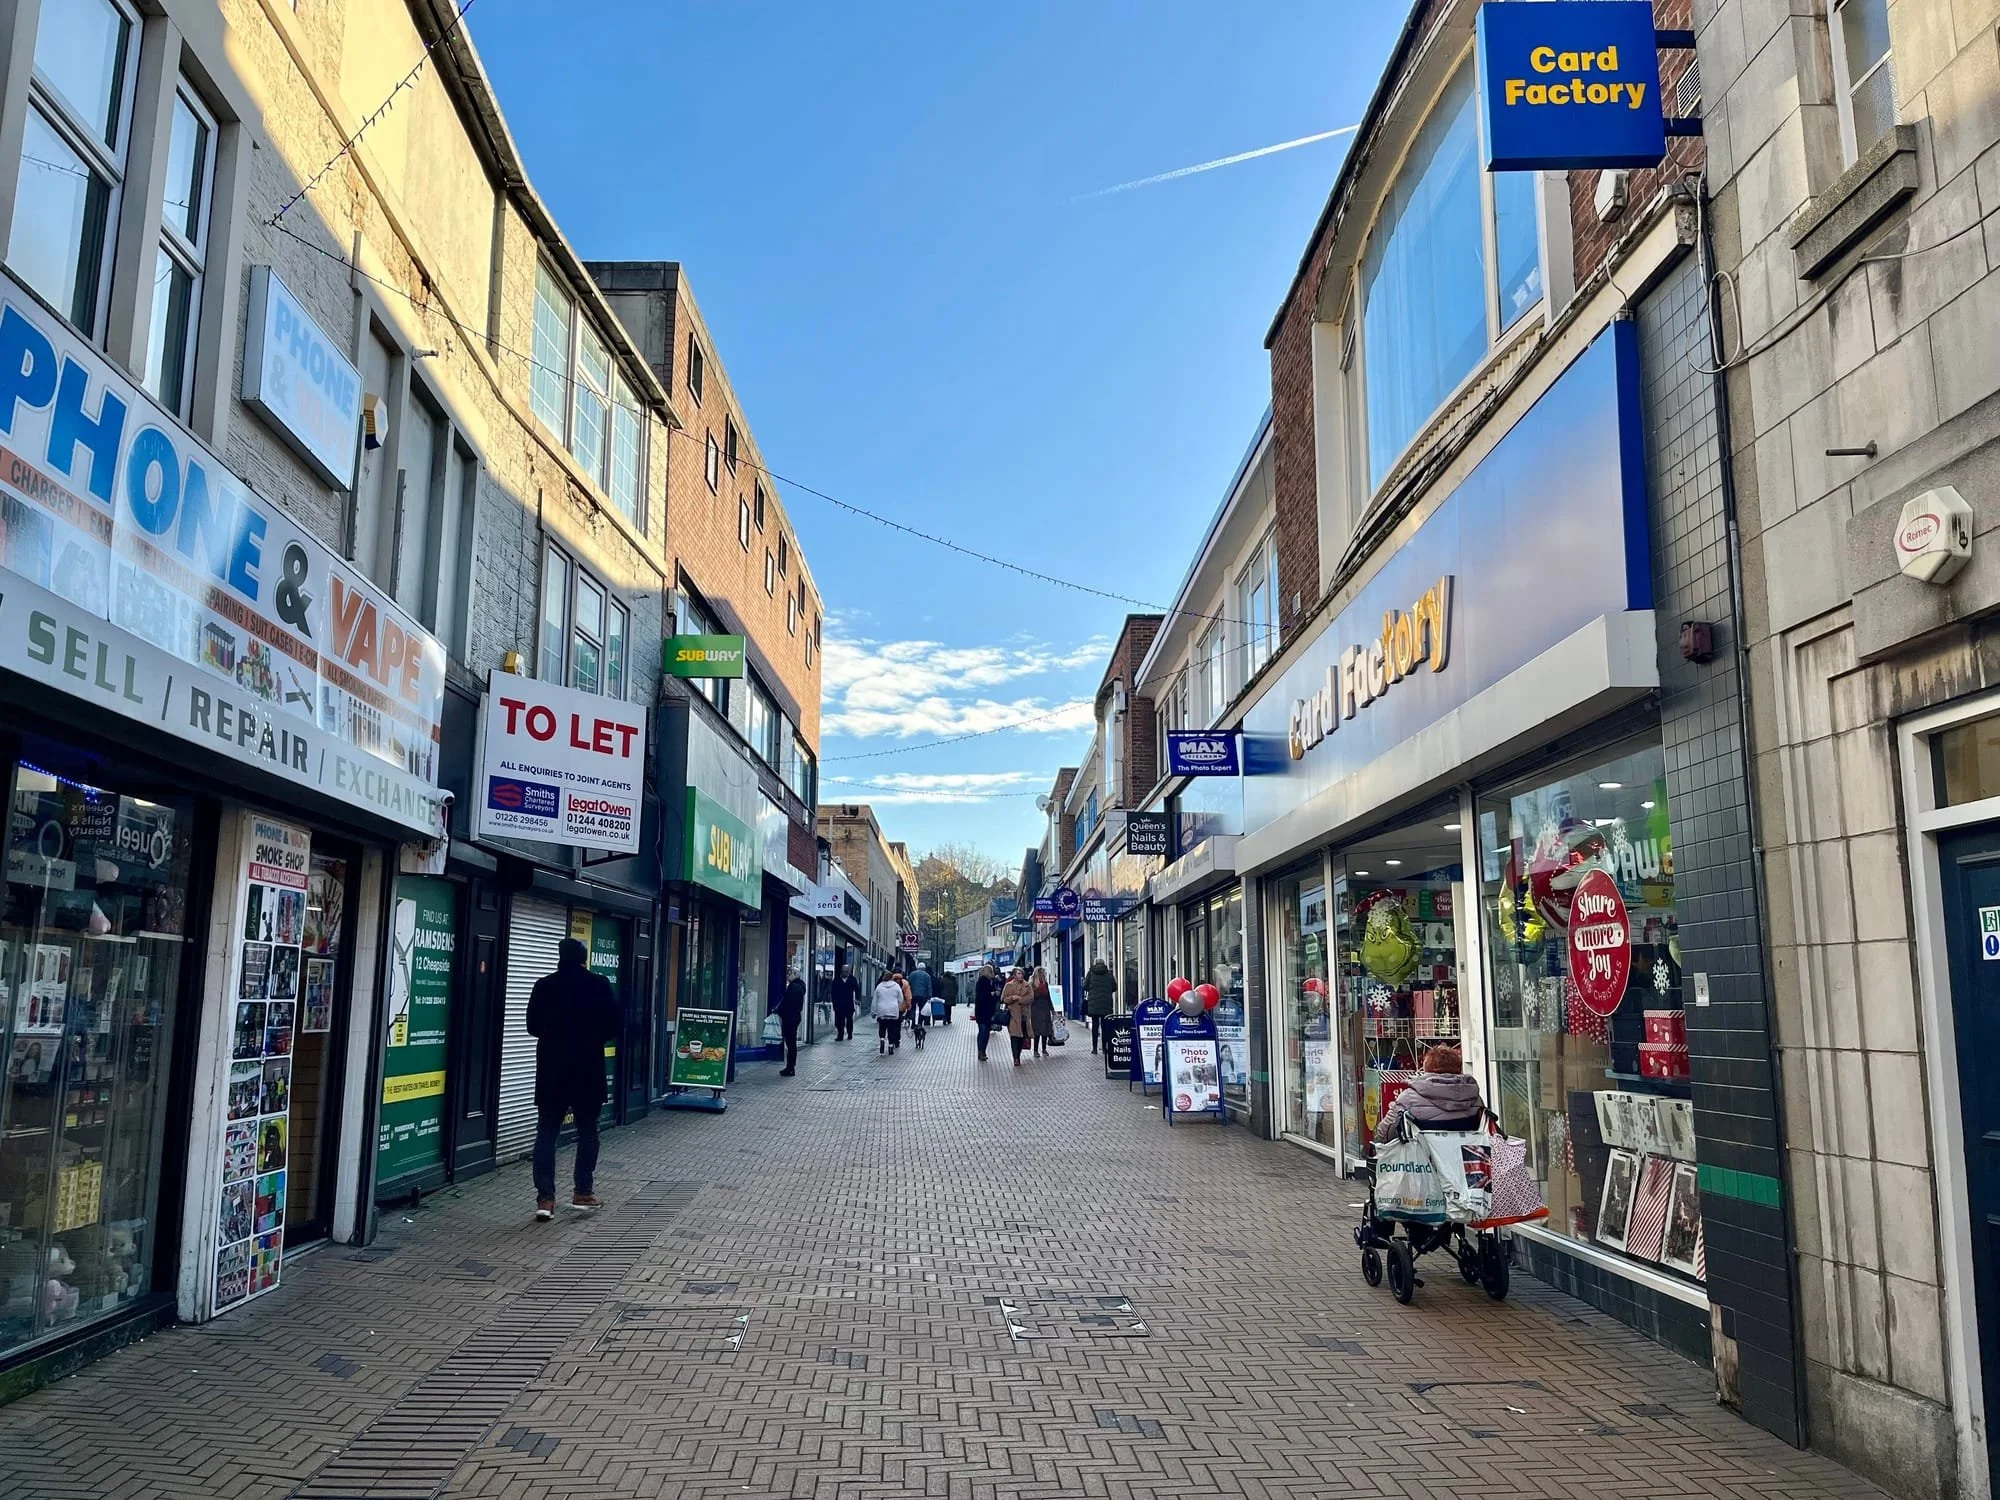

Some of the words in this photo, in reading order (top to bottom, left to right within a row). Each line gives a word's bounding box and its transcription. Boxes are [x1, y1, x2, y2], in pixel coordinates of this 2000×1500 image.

[1530, 46, 1618, 73] Card
[1505, 78, 1646, 109] Factory
[274, 297, 355, 420] PHONE
[0, 306, 268, 602] PHONE
[275, 541, 314, 640] &
[331, 573, 424, 705] VAPE
[1907, 525, 1932, 543] Romec
[250, 613, 268, 638] SUIT
[269, 624, 294, 655] CASES
[675, 649, 741, 663] SUBWAY
[1288, 665, 1338, 760] Card
[1340, 575, 1455, 719] Factory
[28, 609, 143, 705] SELL
[190, 685, 309, 774] REPAIR
[335, 755, 437, 827] EXCHANGE
[499, 697, 557, 742] TO
[570, 713, 639, 758] LET
[1179, 741, 1226, 753] MAX
[500, 761, 517, 771] ALL
[518, 764, 563, 779] ENQUIRIES
[564, 772, 575, 781] TO
[576, 774, 600, 786] JOINT
[601, 779, 632, 791] AGENTS
[524, 796, 555, 807] Chartered
[525, 786, 555, 800] Smiths
[524, 802, 555, 813] Surveyors
[495, 812, 518, 823] 01226
[519, 815, 549, 827] 298456
[567, 813, 595, 827] 01244
[598, 816, 631, 832] 408200
[1129, 821, 1166, 832] Queen's
[255, 822, 282, 843] PHONE
[1131, 834, 1156, 843] Nails
[1158, 834, 1166, 843] &
[708, 824, 753, 883] SUBWAY
[1131, 842, 1167, 853] Beauty
[255, 843, 284, 867] SMOKE
[285, 851, 305, 872] SHOP
[1577, 891, 1616, 922] Share
[423, 909, 435, 922] FIND
[435, 911, 442, 924] US
[442, 914, 449, 925] AT
[414, 927, 456, 952] RAMSDENS
[597, 938, 605, 947] FIND
[1580, 924, 1614, 948] more
[416, 956, 422, 970] 12
[422, 956, 451, 975] Cheapside
[591, 951, 620, 968] RAMSDENS
[1588, 950, 1612, 982] Joy
[1580, 968, 1593, 995] THIS
[1592, 959, 1622, 1001] CHRISTMAS
[1180, 1048, 1209, 1056] Photo
[1184, 1056, 1206, 1064] Gifts
[1379, 1161, 1432, 1174] Poundland
[1402, 1197, 1425, 1207] Value
